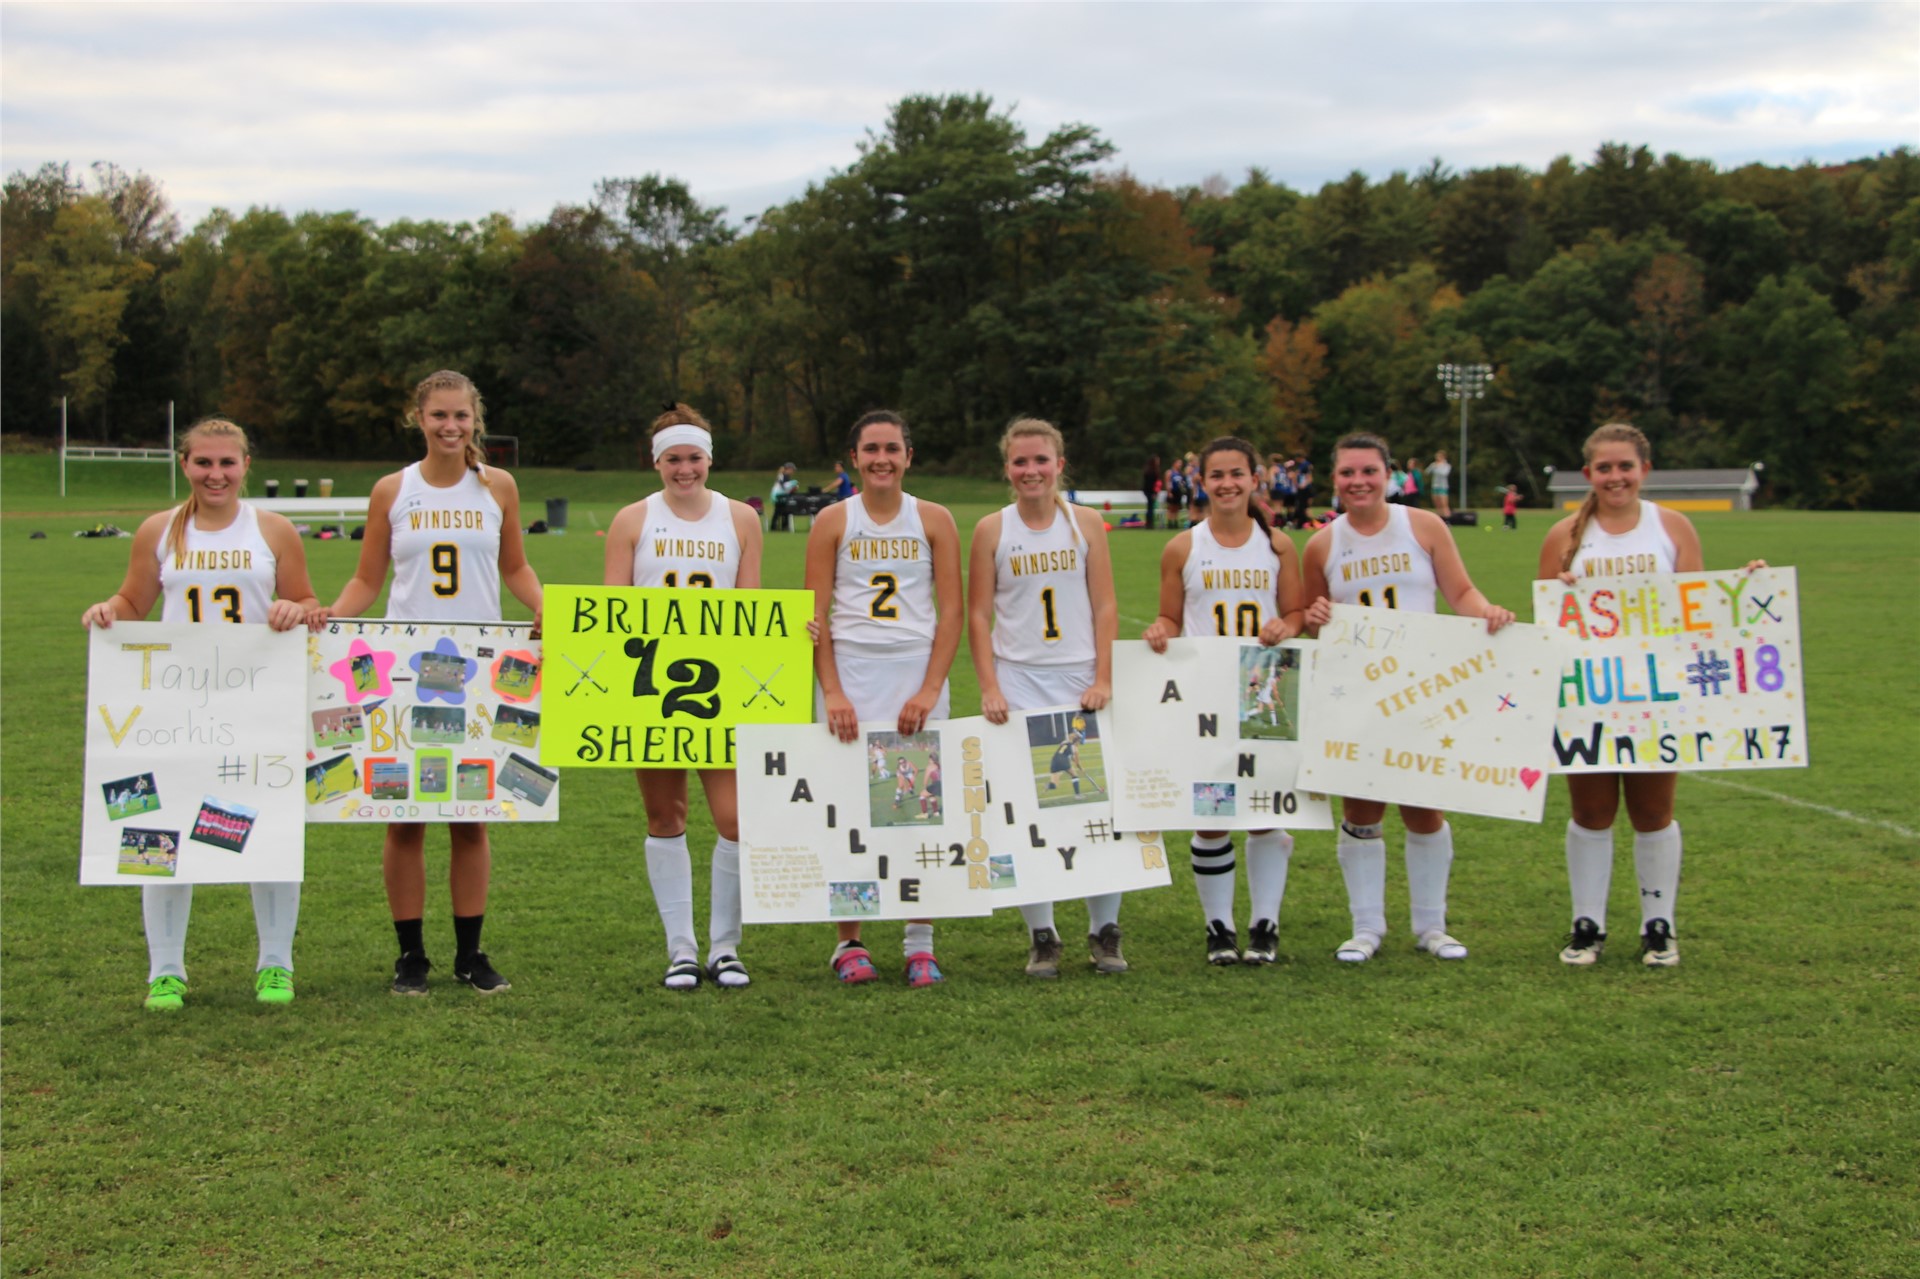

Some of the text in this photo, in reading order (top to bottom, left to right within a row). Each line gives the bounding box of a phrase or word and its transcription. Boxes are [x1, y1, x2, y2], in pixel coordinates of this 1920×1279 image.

[410, 510, 484, 531] WINDSOR
[174, 550, 252, 571] WINDSOR
[654, 539, 725, 562] WINDSOR
[850, 539, 919, 561] WINDSOR
[1010, 549, 1077, 577] WINDSOR
[1341, 552, 1411, 582] WINDSOR
[1583, 554, 1656, 578] WINDSOR
[431, 541, 461, 598] 9
[1202, 569, 1270, 590] WINDSOR
[186, 585, 242, 623] 13
[870, 572, 899, 620] 2
[1040, 585, 1061, 641] 1
[1558, 577, 1747, 640] ASHLEY
[571, 597, 789, 637] BRIANNA
[121, 643, 267, 708] Taylor
[623, 636, 721, 720] 12
[1364, 654, 1398, 682] GO
[1376, 649, 1496, 718] TIFFANY!
[1559, 644, 1785, 708] HULL #18
[98, 704, 235, 748] Voorhis
[371, 704, 414, 752] BK
[1419, 698, 1469, 730] #11
[1552, 719, 1791, 767] Windsor 2K17
[217, 753, 294, 789] #13
[1324, 739, 1517, 787] WE LOVE YOU!
[358, 803, 502, 819] GOOD LUCK
[961, 735, 992, 890] SENIOR
[1249, 789, 1297, 815] #10
[915, 842, 966, 870] #2
